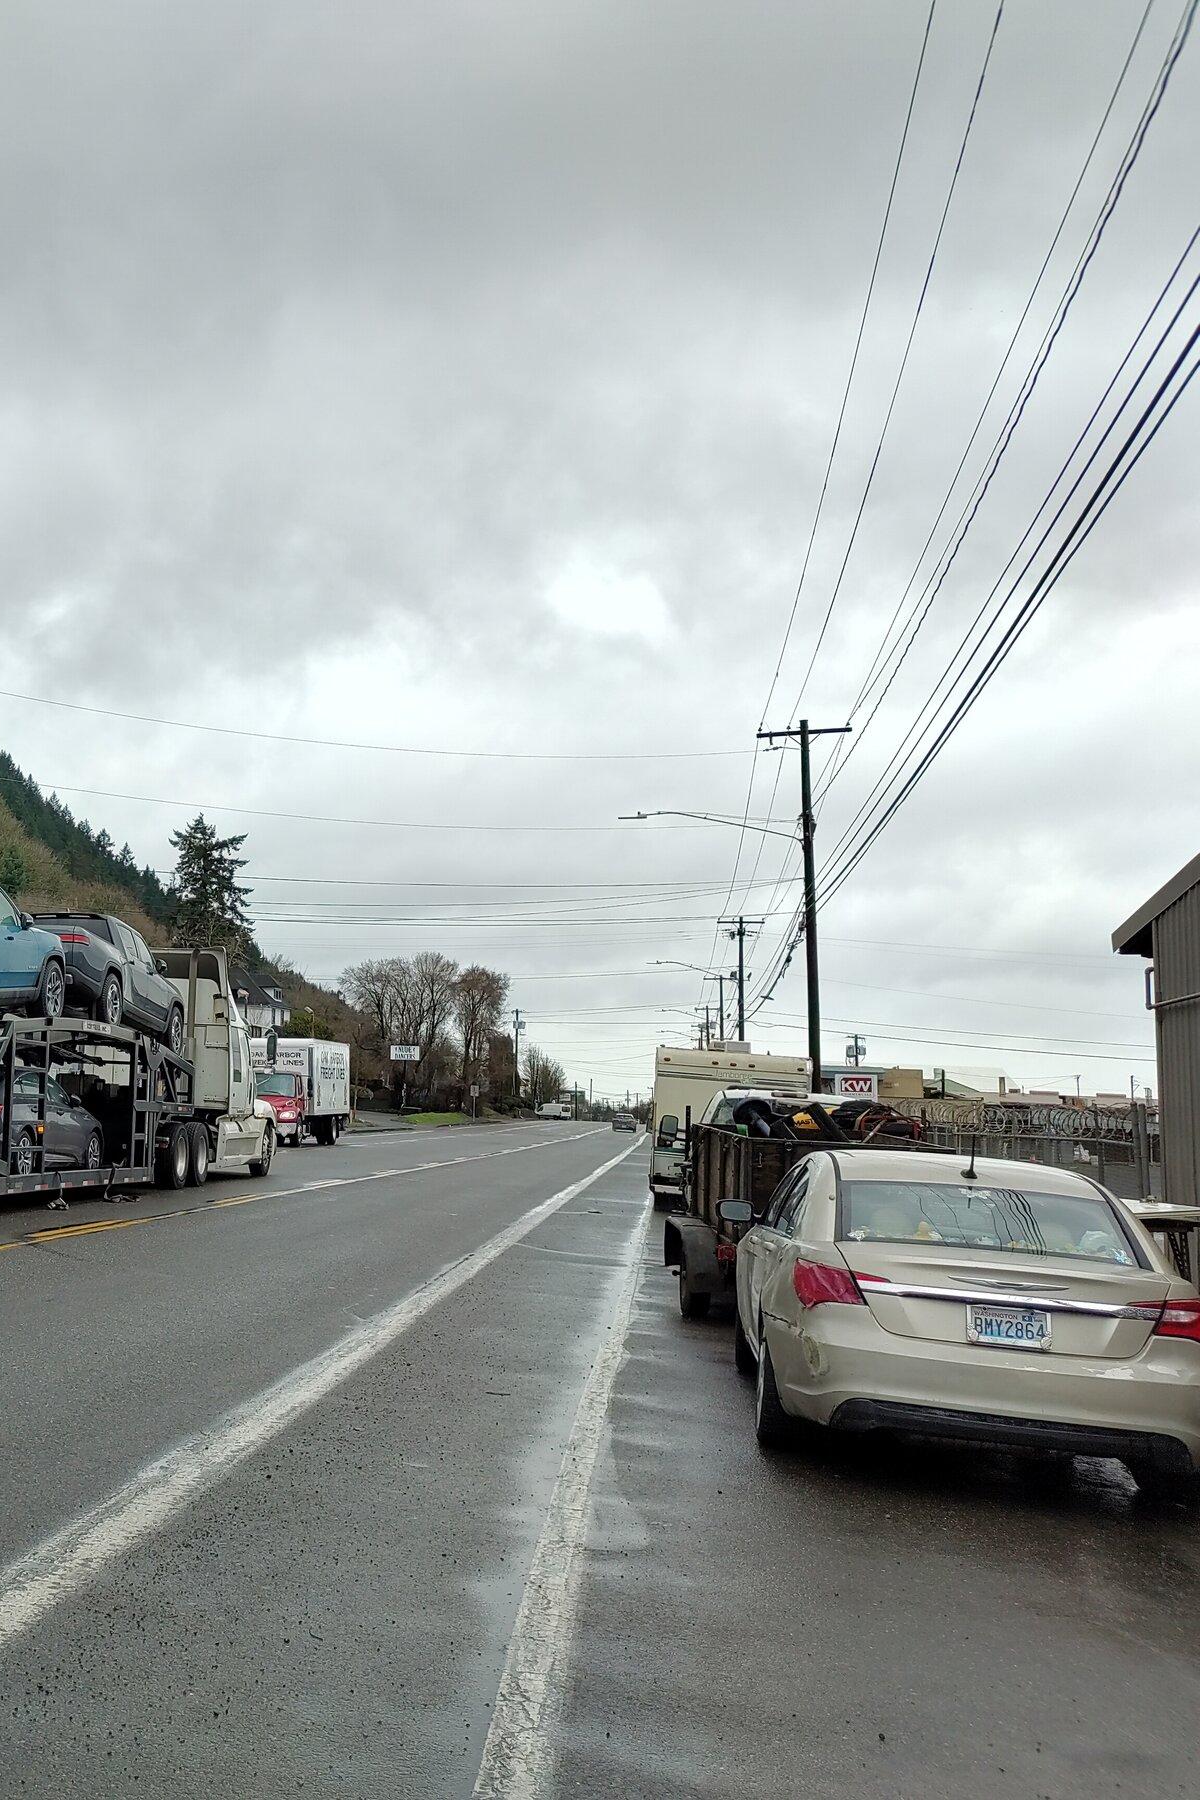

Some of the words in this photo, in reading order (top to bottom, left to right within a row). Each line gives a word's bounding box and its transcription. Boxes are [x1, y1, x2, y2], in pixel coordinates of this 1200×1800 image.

[714, 1069, 753, 1079] Jamboree
[841, 1080, 872, 1092] KW
[973, 1310, 1018, 1320] WASHINGTON
[974, 1317, 1045, 1340] BMY2864
